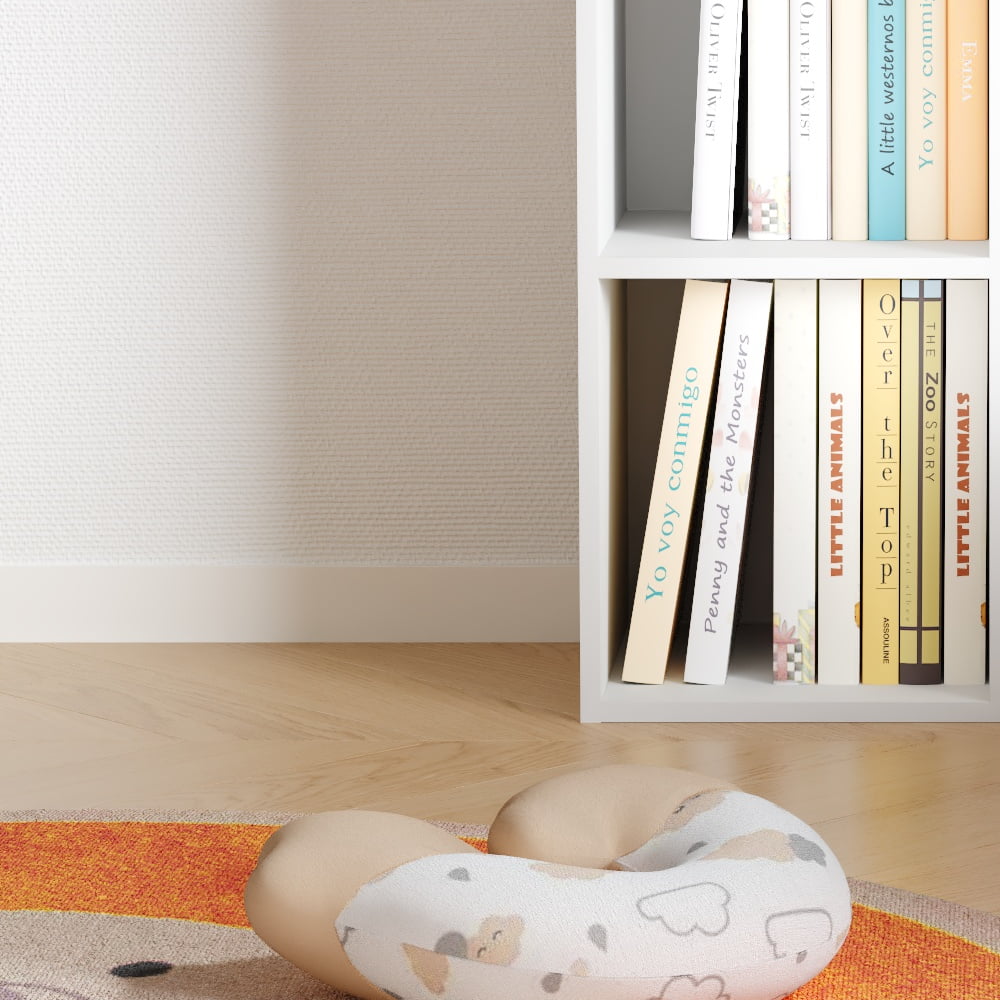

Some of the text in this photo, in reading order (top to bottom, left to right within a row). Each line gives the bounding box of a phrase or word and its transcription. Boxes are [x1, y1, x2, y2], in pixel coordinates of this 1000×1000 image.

[881, 14, 894, 104] westernos
[880, 112, 894, 154] little
[922, 87, 937, 129] voy
[881, 162, 895, 176] A
[918, 139, 934, 170] Yo
[925, 322, 936, 357] THE
[645, 366, 699, 603] Yo voy conmigo
[704, 333, 750, 633] Penny and the Monsters
[830, 392, 844, 577] LITTLE ANIMALS
[956, 392, 970, 577] LITTLE ANIMALS
[880, 507, 895, 585] Top
[882, 617, 890, 664] ASSOULINE
